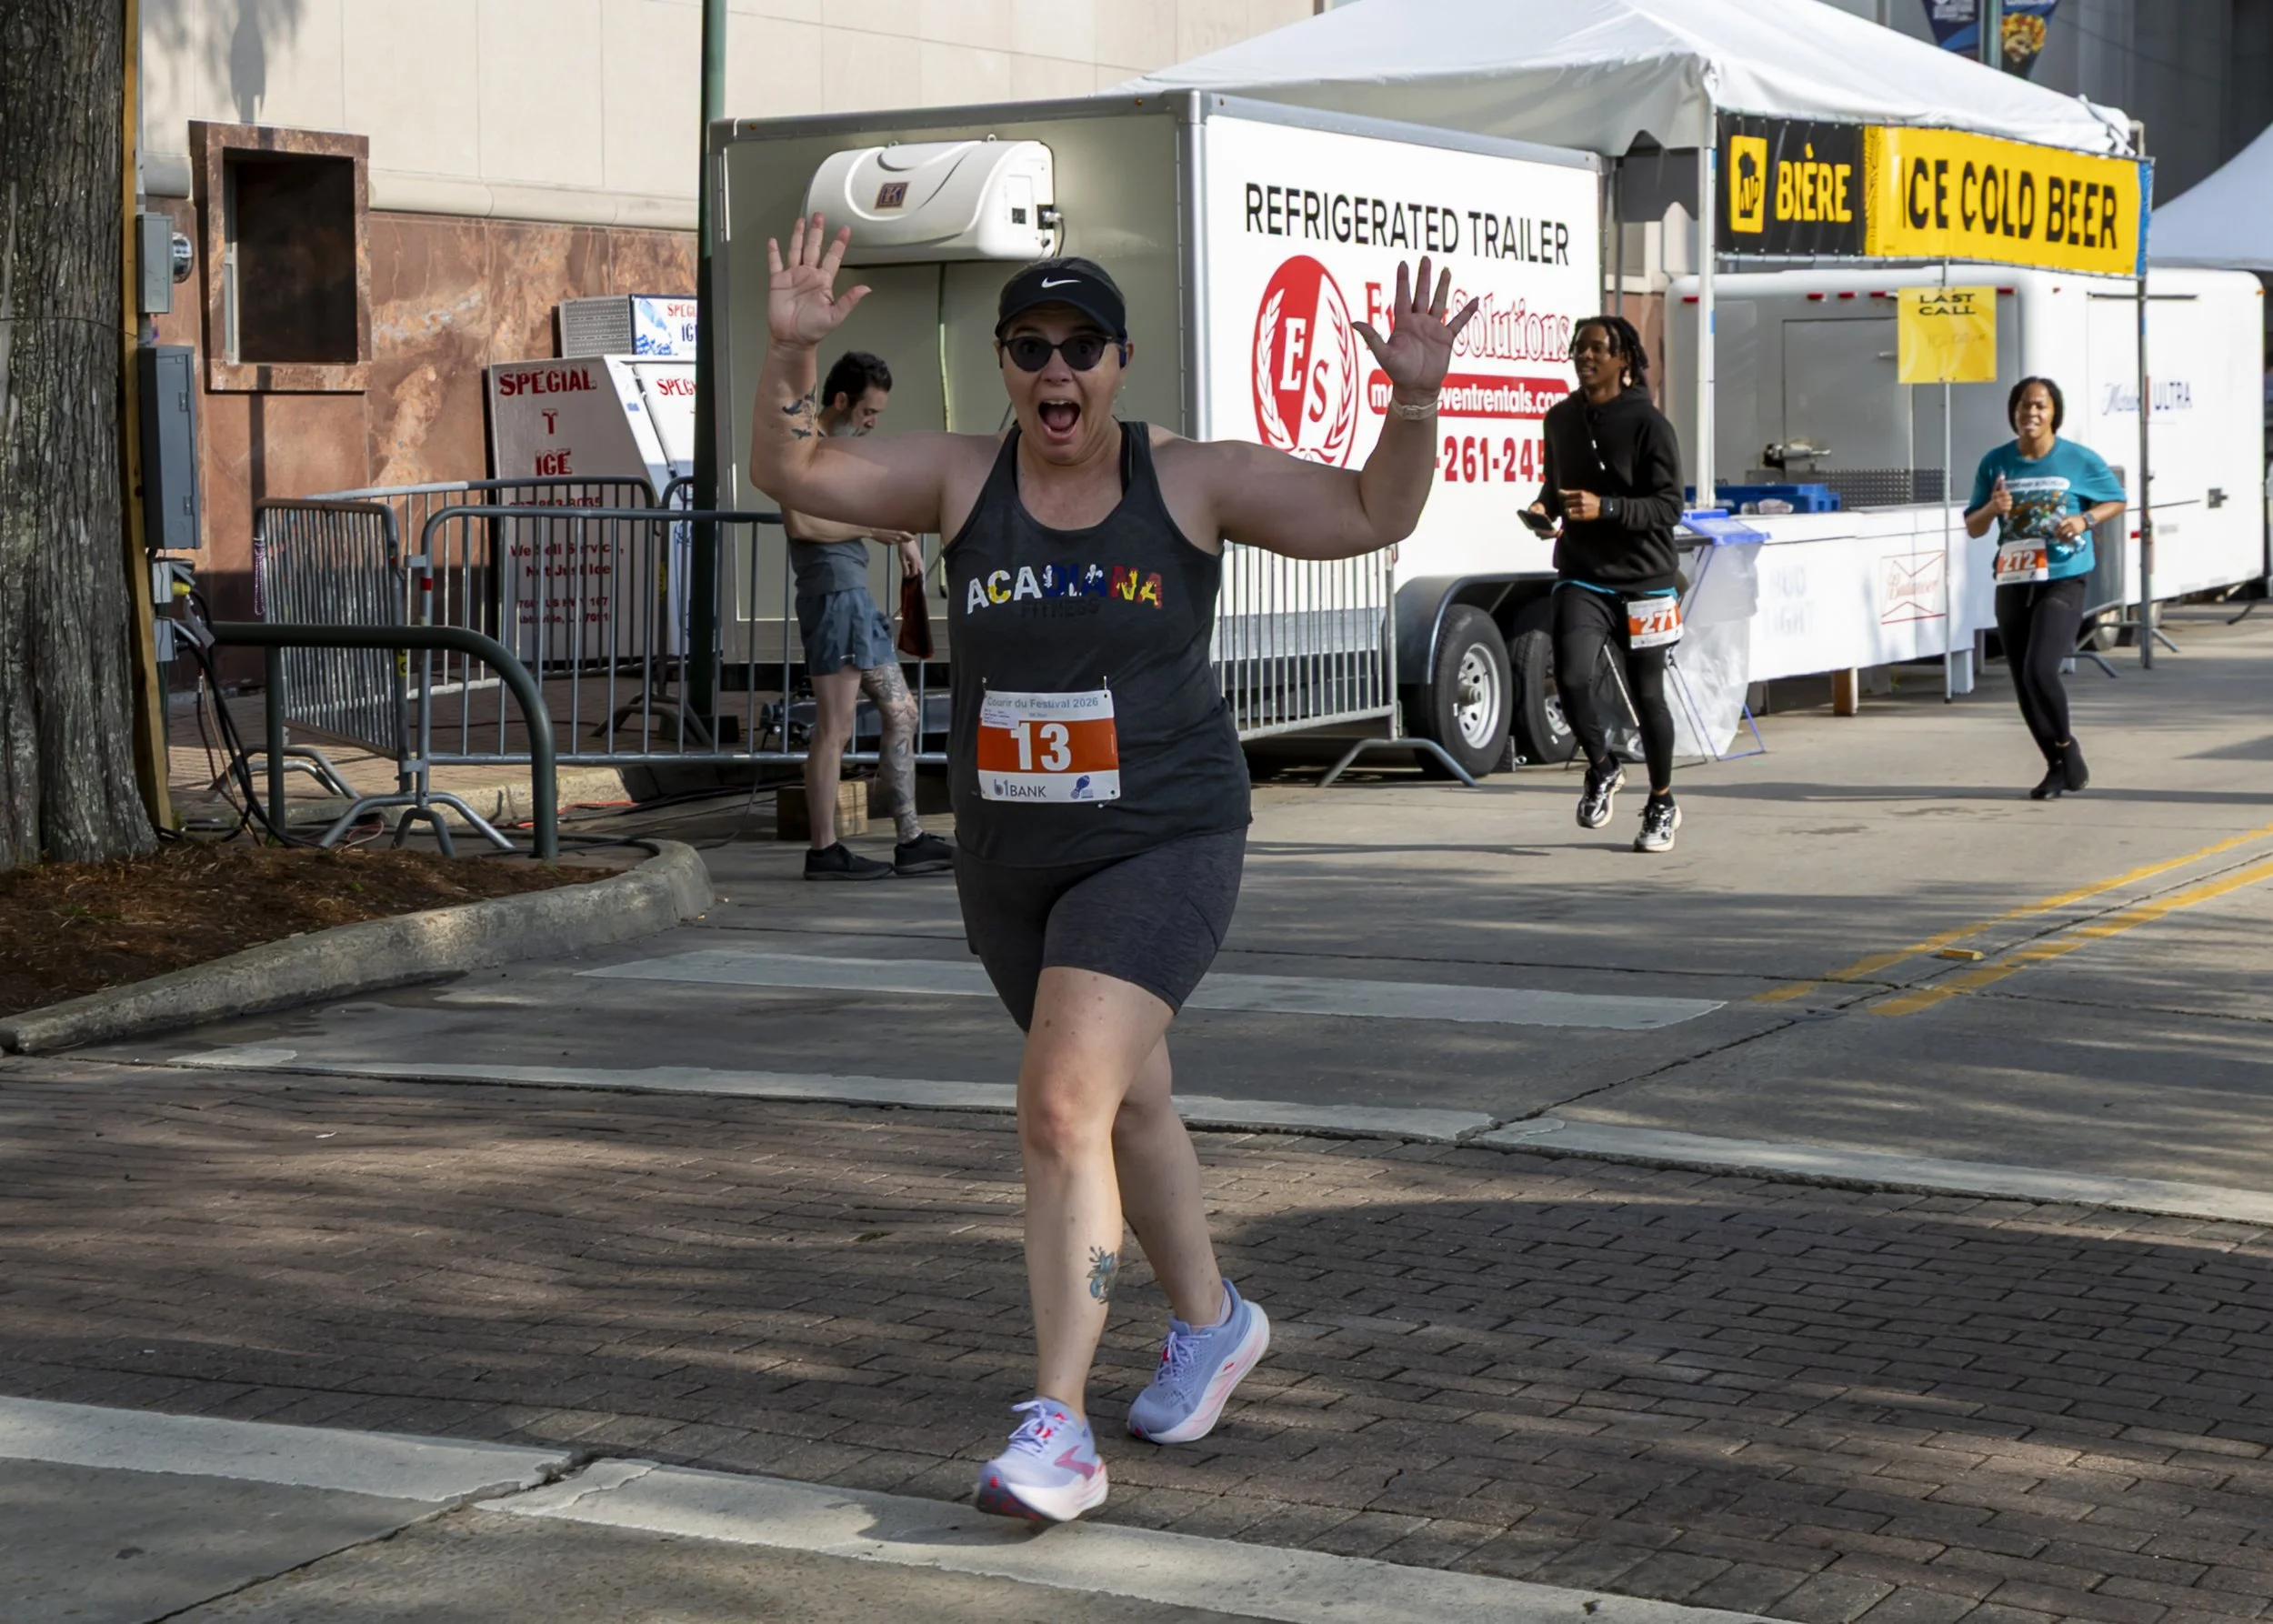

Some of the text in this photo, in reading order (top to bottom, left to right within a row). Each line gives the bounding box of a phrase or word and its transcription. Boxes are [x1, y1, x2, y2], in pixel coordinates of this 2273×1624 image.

[1901, 156, 2118, 250] ICE COLD BEER
[1246, 182, 1570, 266] REFRIGERATED TRAILER
[666, 303, 696, 318] SPECI
[1918, 306, 1977, 316] CALL
[1919, 293, 1976, 304] LAST
[681, 322, 697, 342] IC
[499, 366, 597, 396] SPECIAL
[542, 408, 559, 435] T
[535, 448, 572, 476] ICE
[2003, 550, 2036, 572] 272
[966, 563, 1164, 616] ACADIANA
[1641, 607, 1677, 634] 271
[986, 697, 1099, 709] Courir du Festival 2026
[1010, 722, 1072, 772] 13
